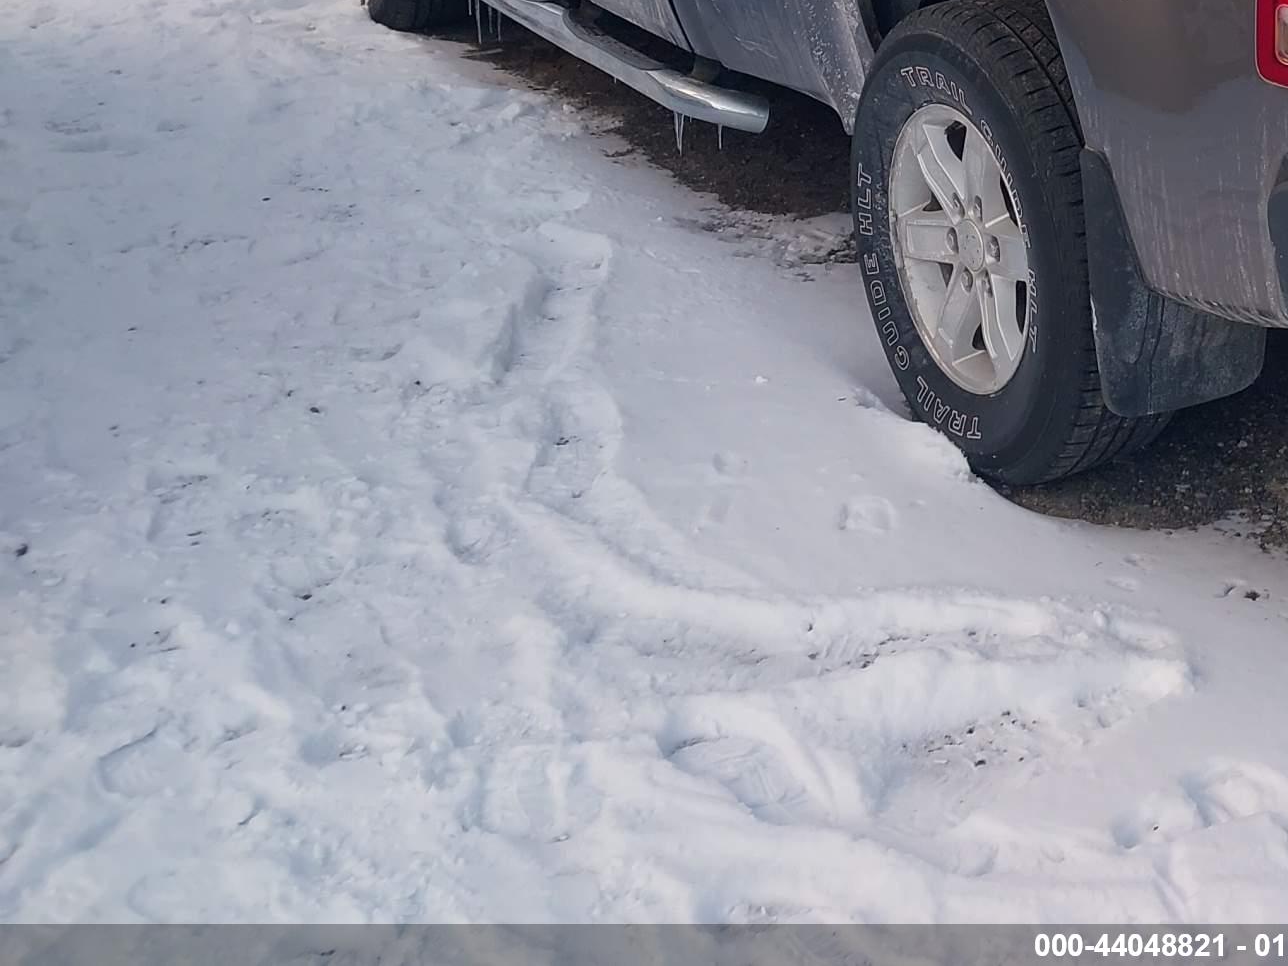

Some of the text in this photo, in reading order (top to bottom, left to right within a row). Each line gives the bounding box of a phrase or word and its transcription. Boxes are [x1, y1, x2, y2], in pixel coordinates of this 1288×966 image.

[900, 66, 974, 116] TRAIL
[857, 162, 983, 440] TRAIL GUIDE HLT
